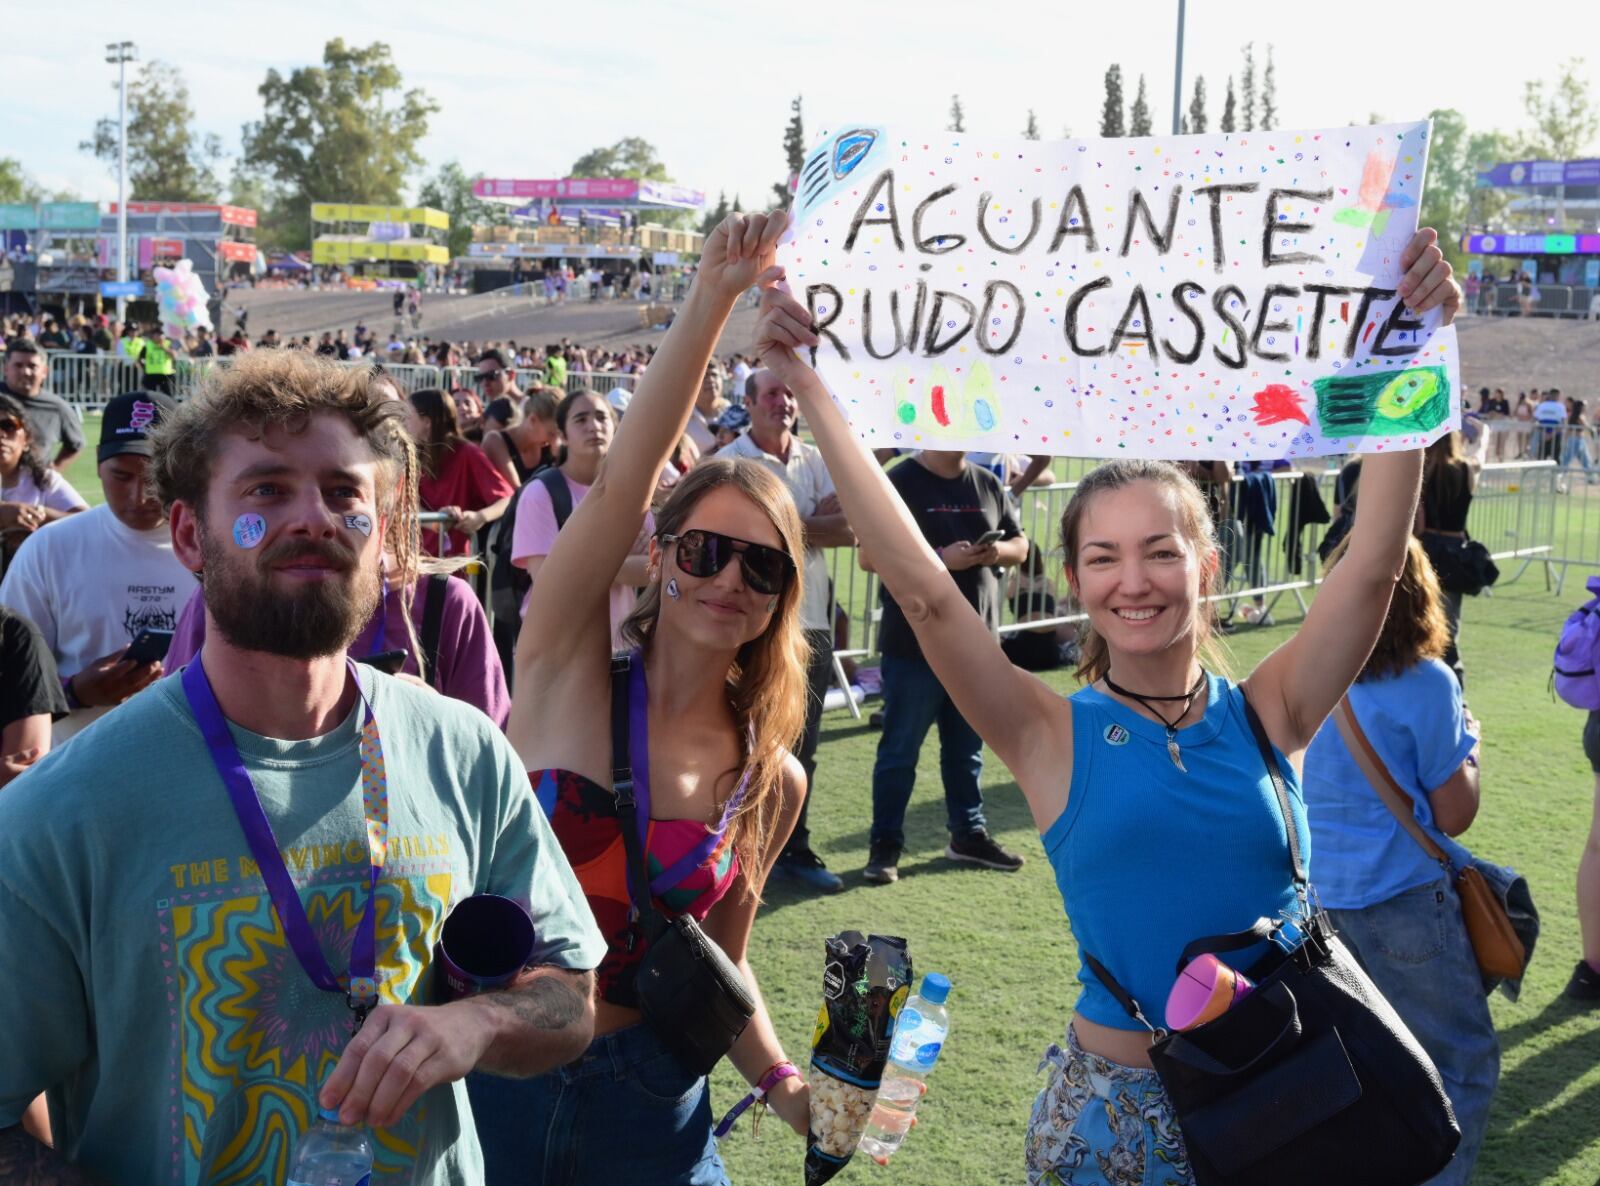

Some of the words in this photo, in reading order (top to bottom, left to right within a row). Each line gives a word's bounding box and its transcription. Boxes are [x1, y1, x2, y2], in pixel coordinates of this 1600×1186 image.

[842, 168, 1335, 274] AGUANTE
[805, 263, 1027, 369] RUIDO
[1063, 275, 1426, 369] CASSETTE
[170, 858, 229, 888] THE
[239, 839, 366, 878] MVING
[386, 833, 450, 860] TILLS
